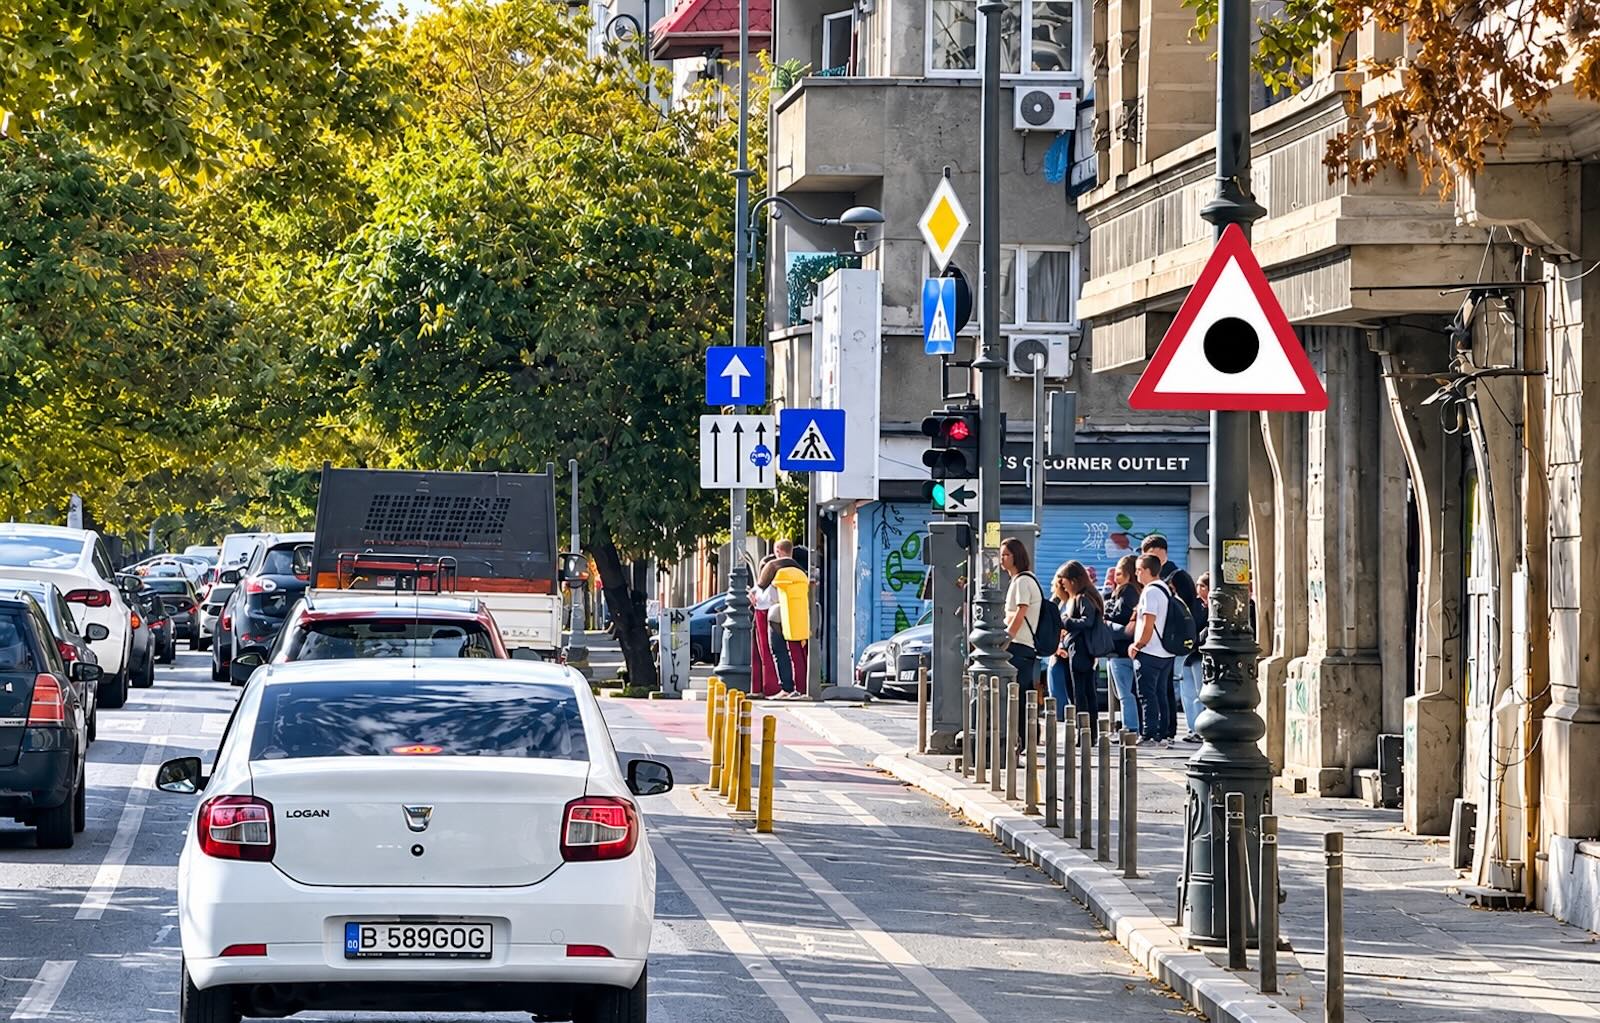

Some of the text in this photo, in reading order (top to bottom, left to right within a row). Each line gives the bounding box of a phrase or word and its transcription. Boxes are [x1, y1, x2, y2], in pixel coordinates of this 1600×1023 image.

[1118, 457, 1190, 470] OUTLET
[286, 809, 330, 818] LOGAN
[361, 927, 484, 949] B 589GOG
